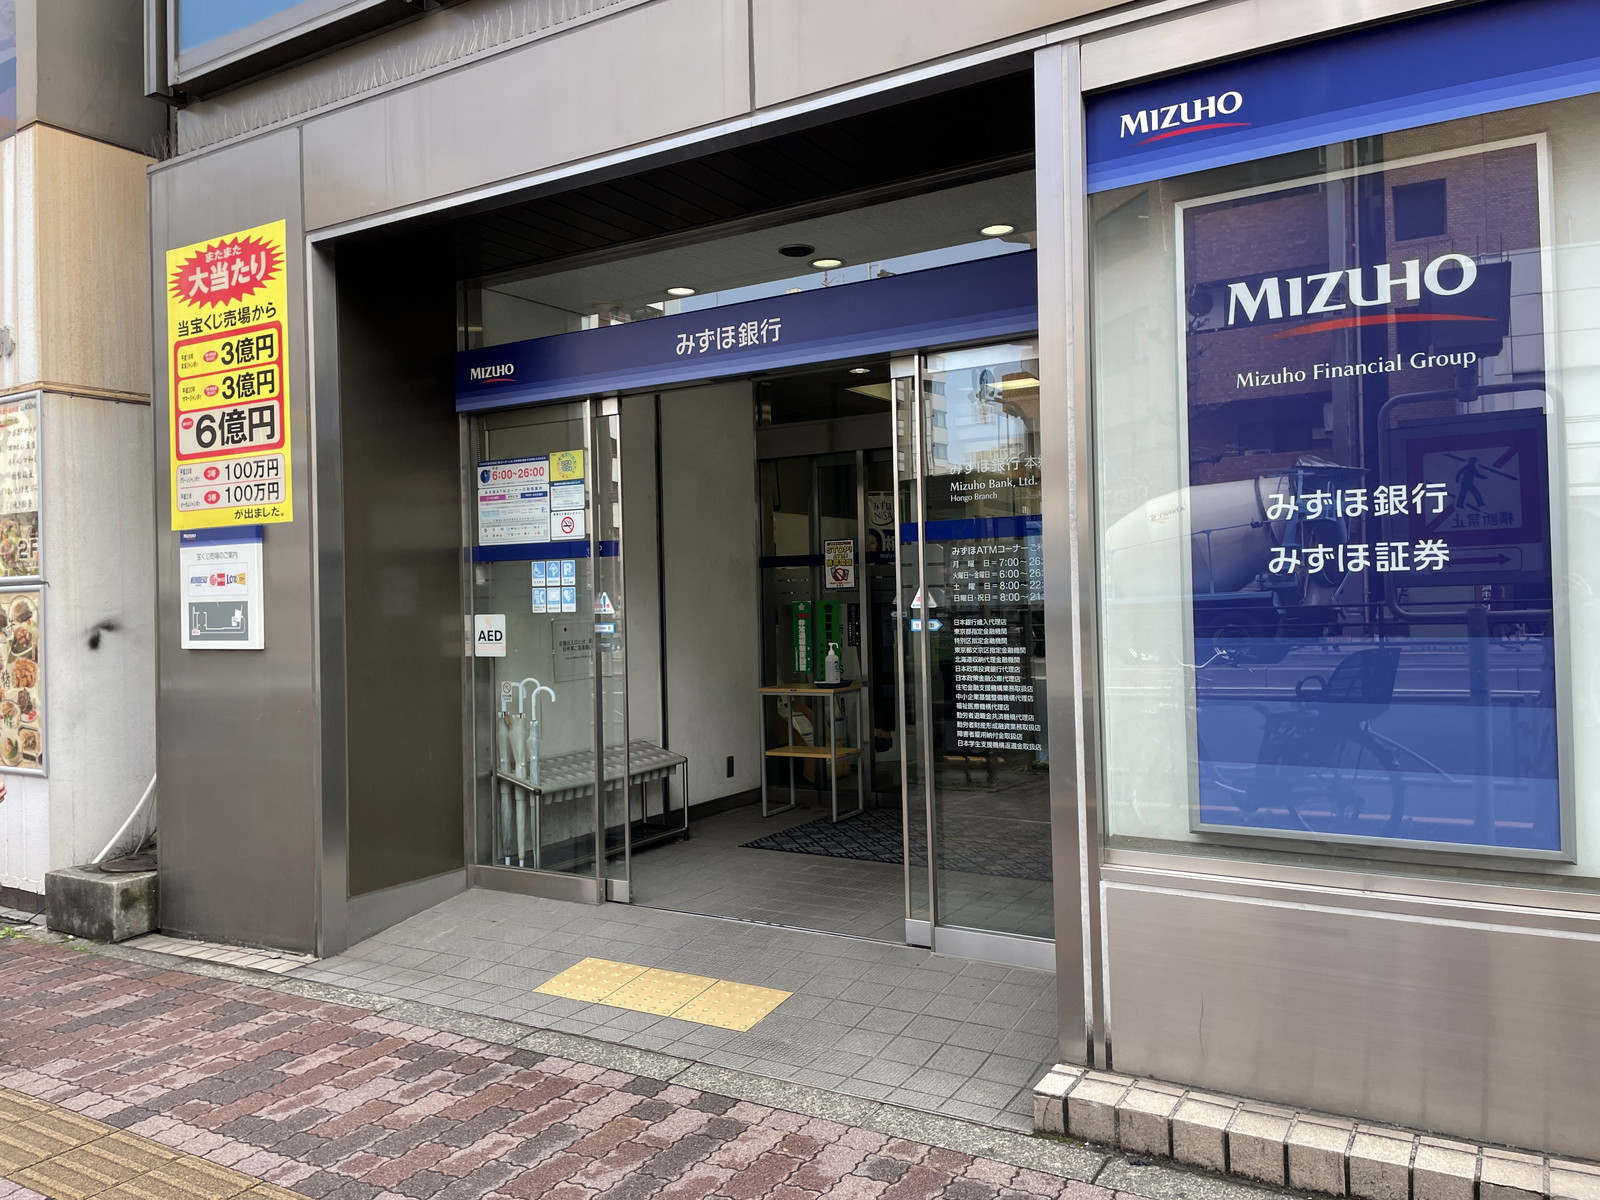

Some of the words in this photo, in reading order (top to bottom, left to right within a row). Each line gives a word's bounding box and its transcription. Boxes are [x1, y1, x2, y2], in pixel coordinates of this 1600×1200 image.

[1120, 91, 1243, 138] MIZUHO
[205, 245, 242, 263] またまた
[188, 251, 267, 298] 大当たり
[1227, 253, 1477, 326] MIZUHO
[178, 302, 277, 337] 当宝くじ売場から
[221, 334, 274, 365] 3億円
[676, 318, 783, 355] みずほ銀行
[470, 363, 515, 381] MIZUHO
[1235, 366, 1306, 389] Mizuho
[1313, 353, 1402, 381] Financial
[1409, 348, 1477, 374] Group
[222, 369, 275, 400] 3億円
[195, 404, 276, 449] 6億円
[225, 458, 279, 481] 100万円
[949, 455, 1020, 475] みずほ銀行
[225, 482, 279, 504] 100万円
[950, 480, 986, 492] Mizuho
[989, 477, 1016, 489] Bank,
[1019, 475, 1038, 486] Ltd.
[872, 501, 892, 511] みずほ
[950, 494, 973, 503] Hongo
[974, 492, 998, 500] Branch
[1266, 482, 1449, 522] みずほ銀行
[234, 506, 284, 520] が出ました。
[874, 512, 893, 521] NISA
[1268, 538, 1450, 575] みずほ証券
[477, 629, 503, 643] AED
